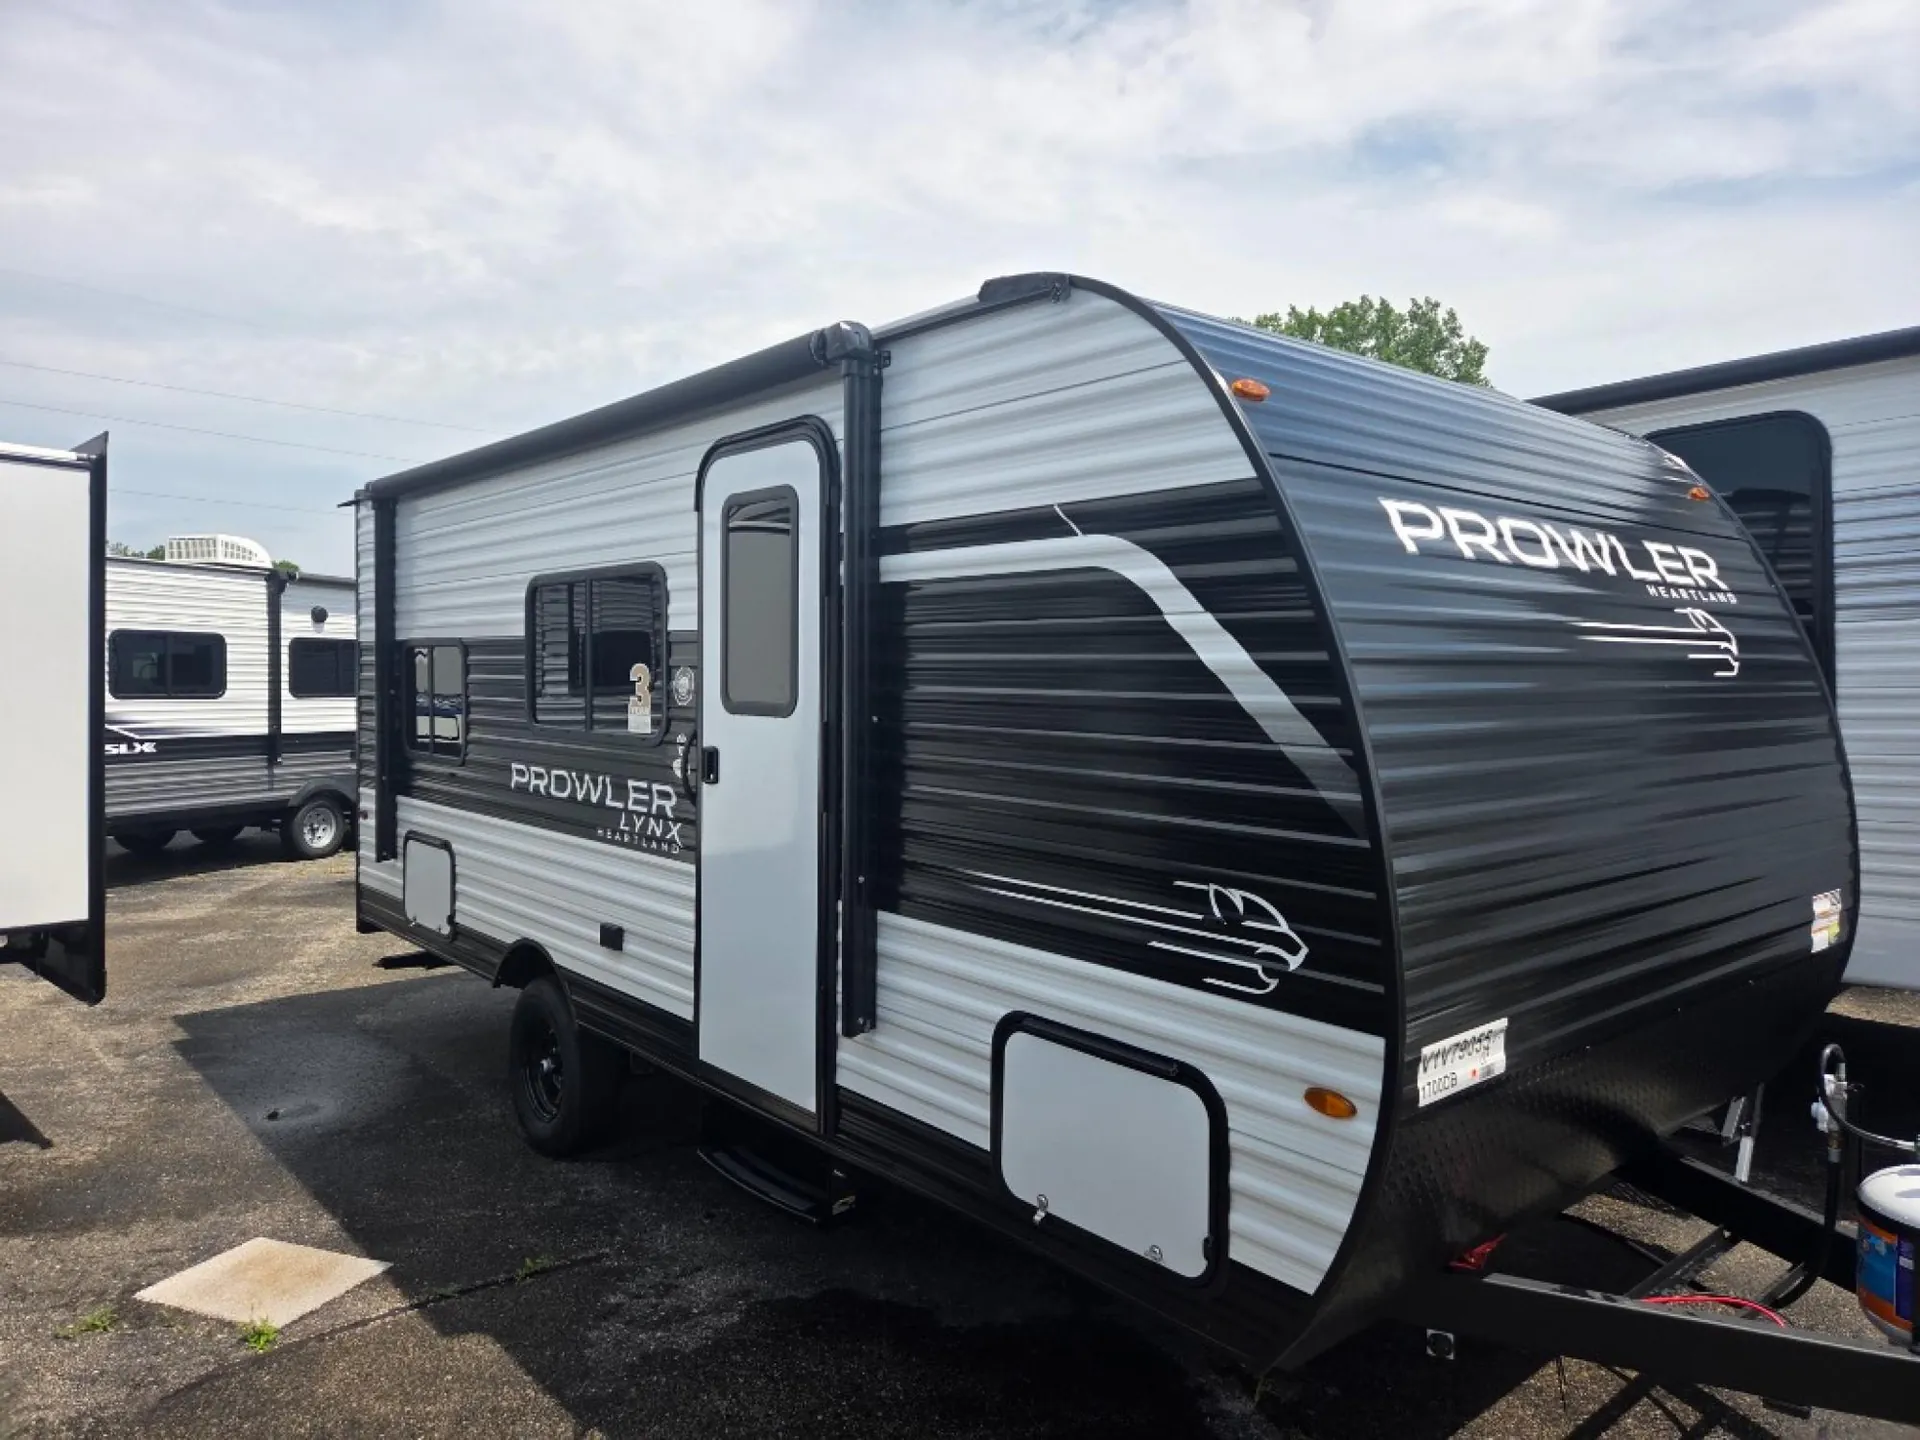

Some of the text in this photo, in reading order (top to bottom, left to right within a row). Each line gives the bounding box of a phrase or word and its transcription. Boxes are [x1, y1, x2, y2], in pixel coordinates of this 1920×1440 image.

[1378, 497, 1728, 590] PROWLER
[1646, 584, 1737, 604] HEARTLAND
[629, 663, 651, 704] 3
[511, 763, 677, 818] PROWLER
[597, 828, 680, 854] HEARTLAND
[619, 812, 682, 847] LYNX
